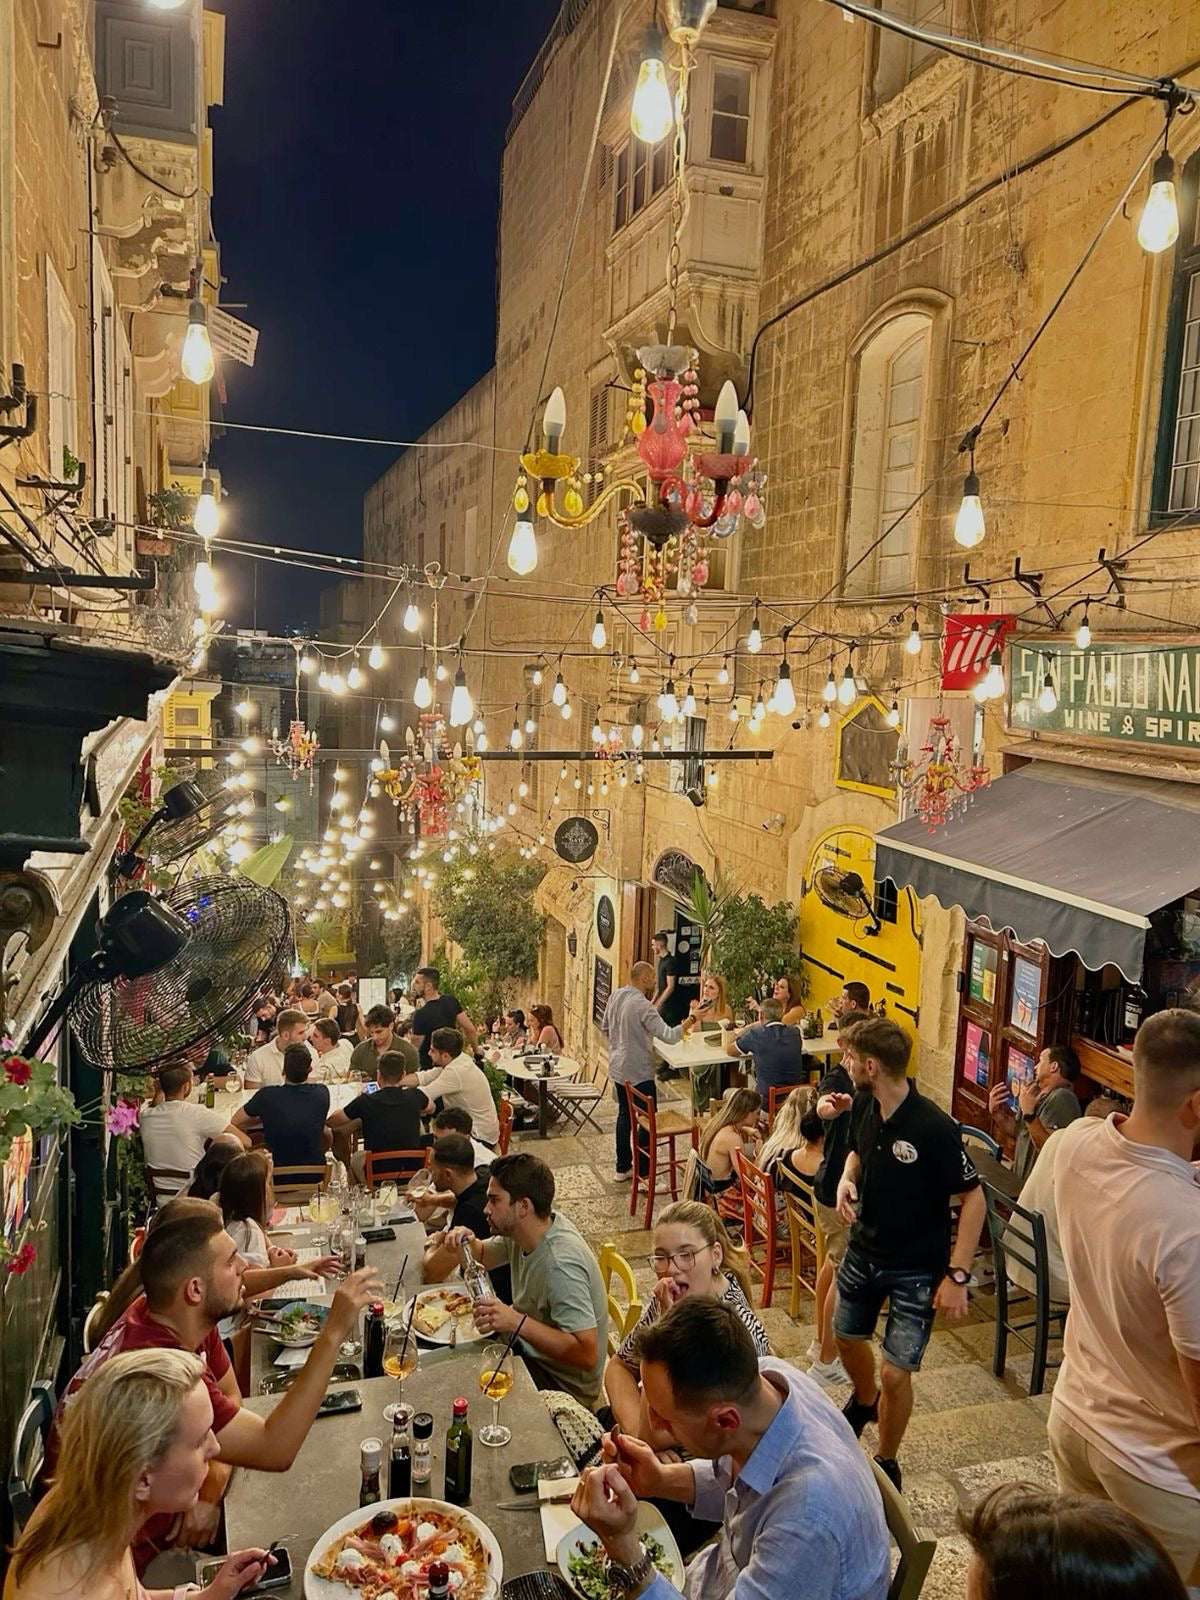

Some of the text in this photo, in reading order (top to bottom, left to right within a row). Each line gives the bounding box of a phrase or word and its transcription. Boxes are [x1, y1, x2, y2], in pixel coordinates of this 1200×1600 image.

[1021, 648, 1061, 702] SAN
[1064, 708, 1110, 732] WINE
[1120, 714, 1134, 735] &
